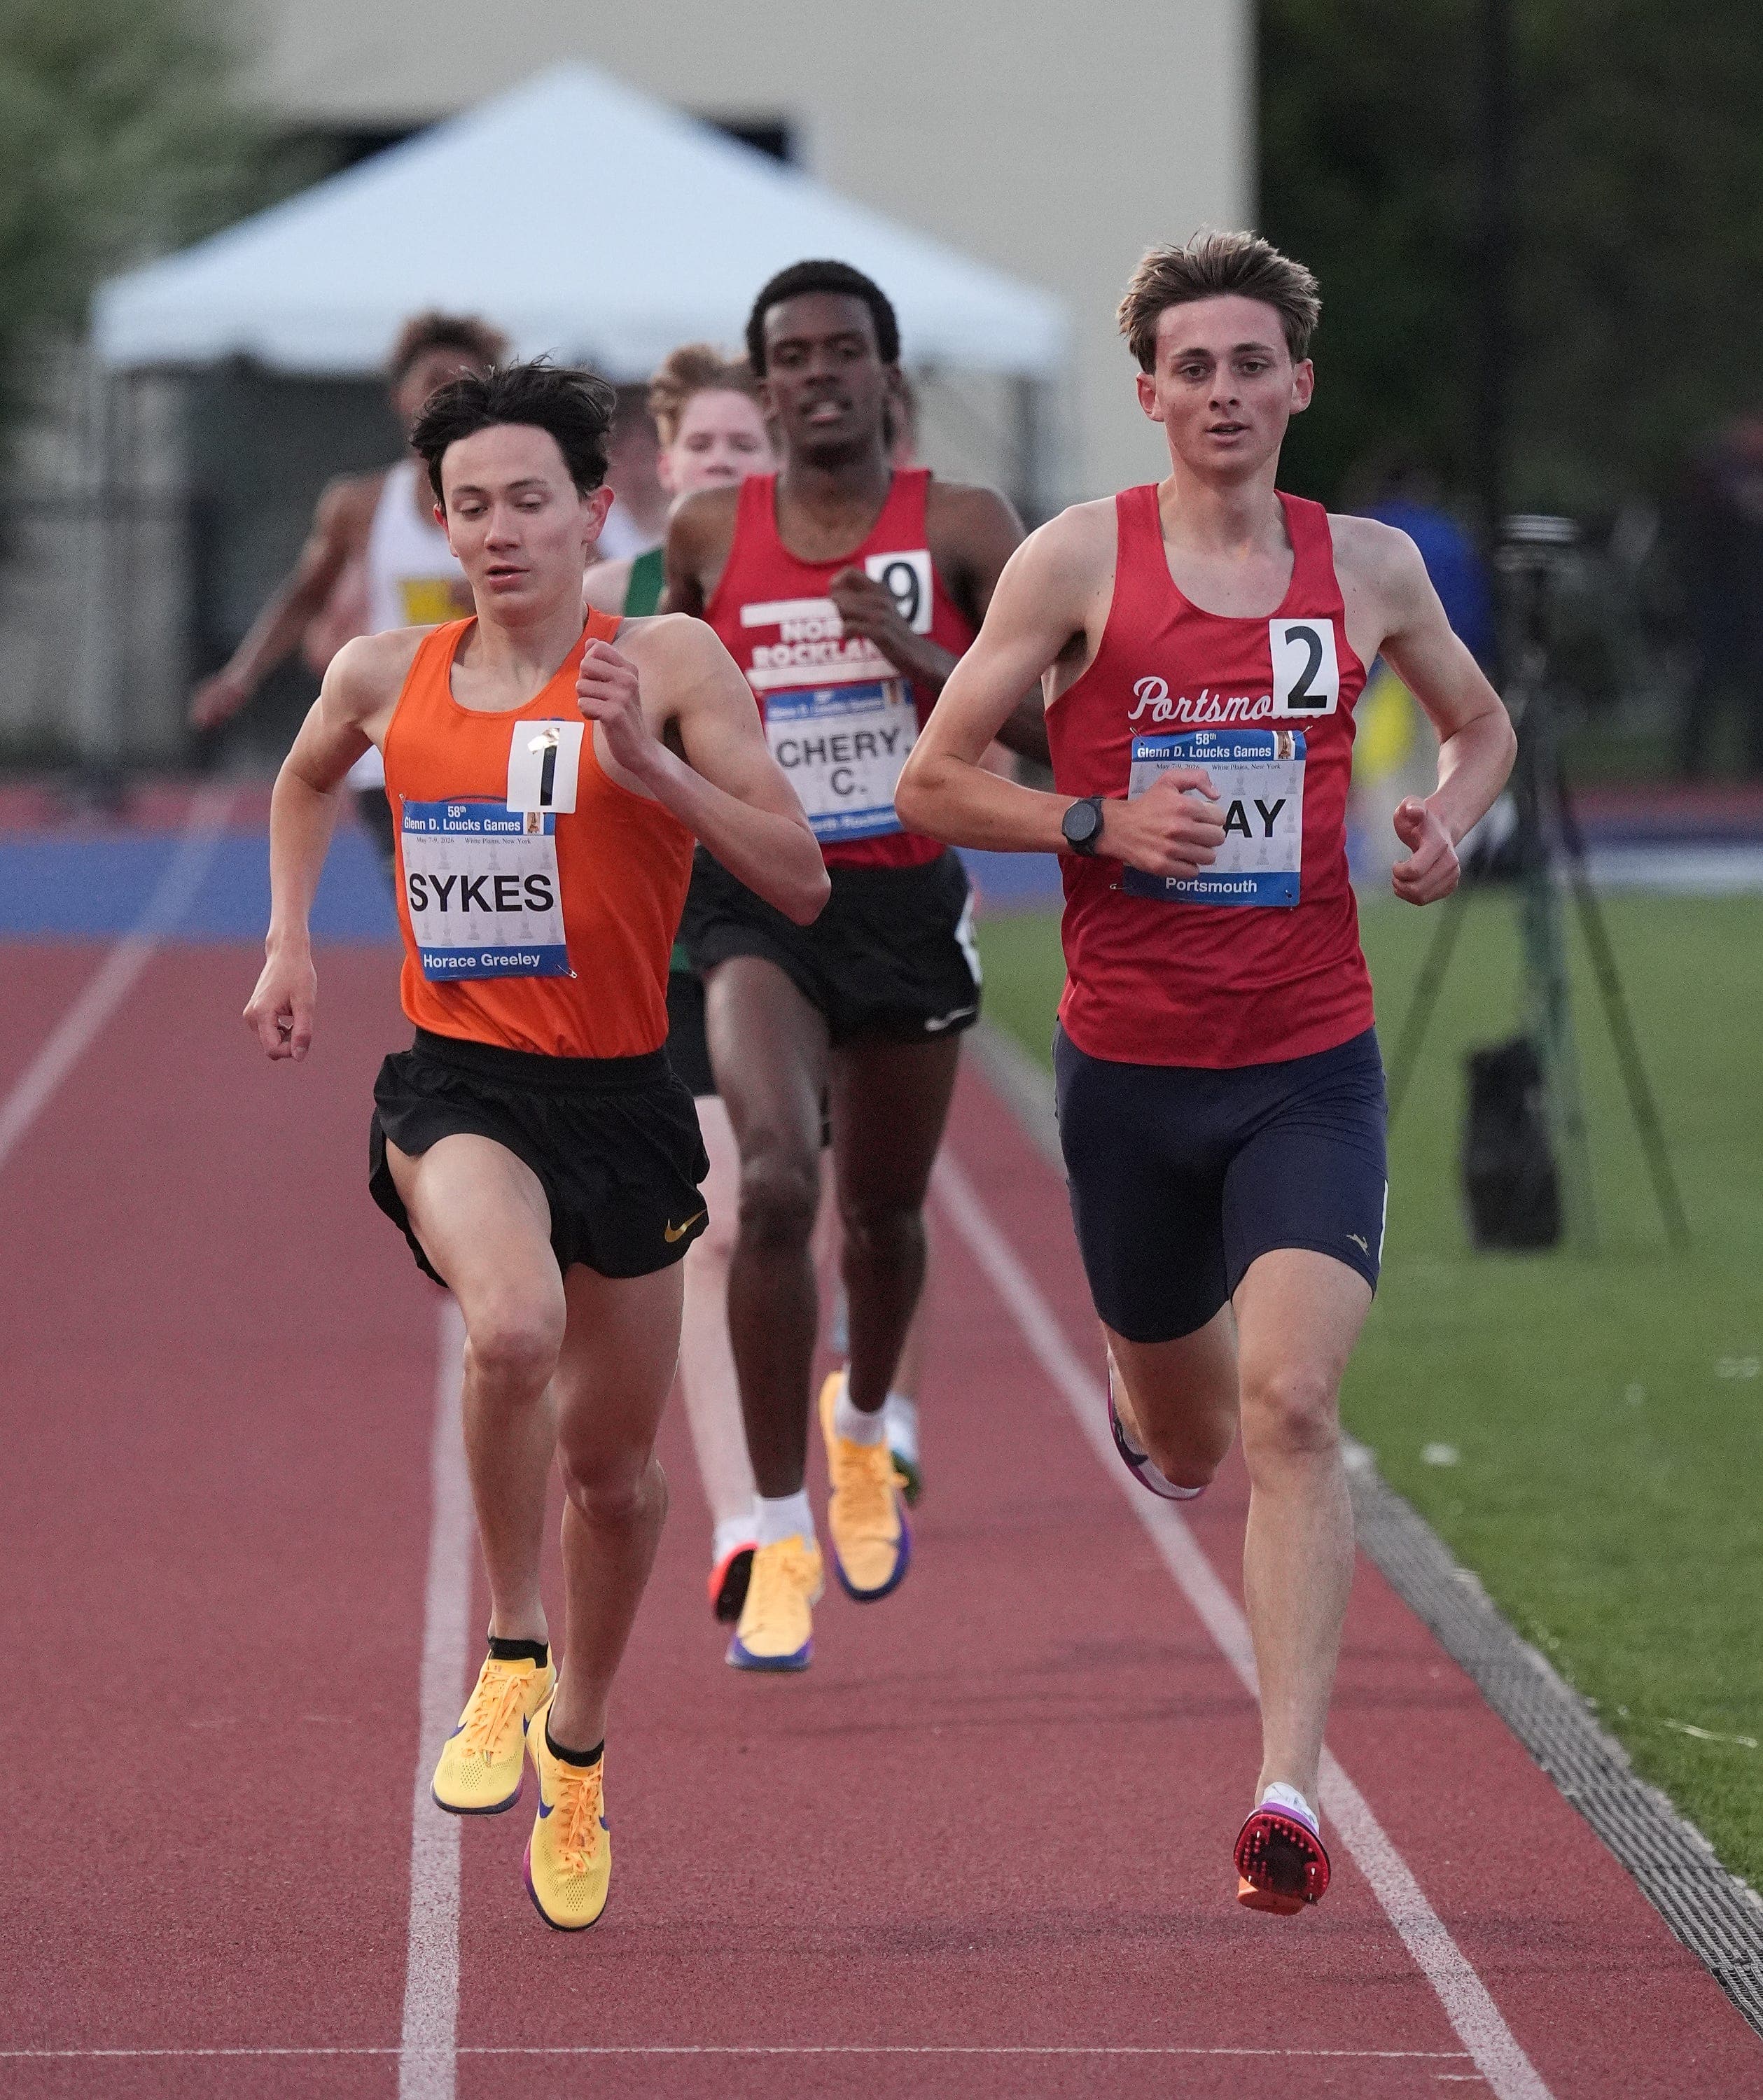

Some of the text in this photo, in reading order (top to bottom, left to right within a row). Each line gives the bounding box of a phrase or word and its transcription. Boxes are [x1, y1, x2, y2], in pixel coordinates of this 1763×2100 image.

[882, 562, 919, 623] 9
[1285, 626, 1328, 709] 2
[1128, 676, 1323, 723] Portsmo
[1137, 746, 1271, 758] Glenn D. Loucks Games
[1195, 733, 1217, 746] 58th
[527, 728, 561, 806] 1
[830, 767, 869, 797] C.
[404, 818, 521, 832] Glenn D. Loucks Games
[447, 805, 466, 818] 58th
[1225, 799, 1286, 839] AY
[409, 873, 555, 913] SYKES
[1165, 877, 1257, 894] Portsmouth
[424, 952, 541, 969] Horace Greeley
